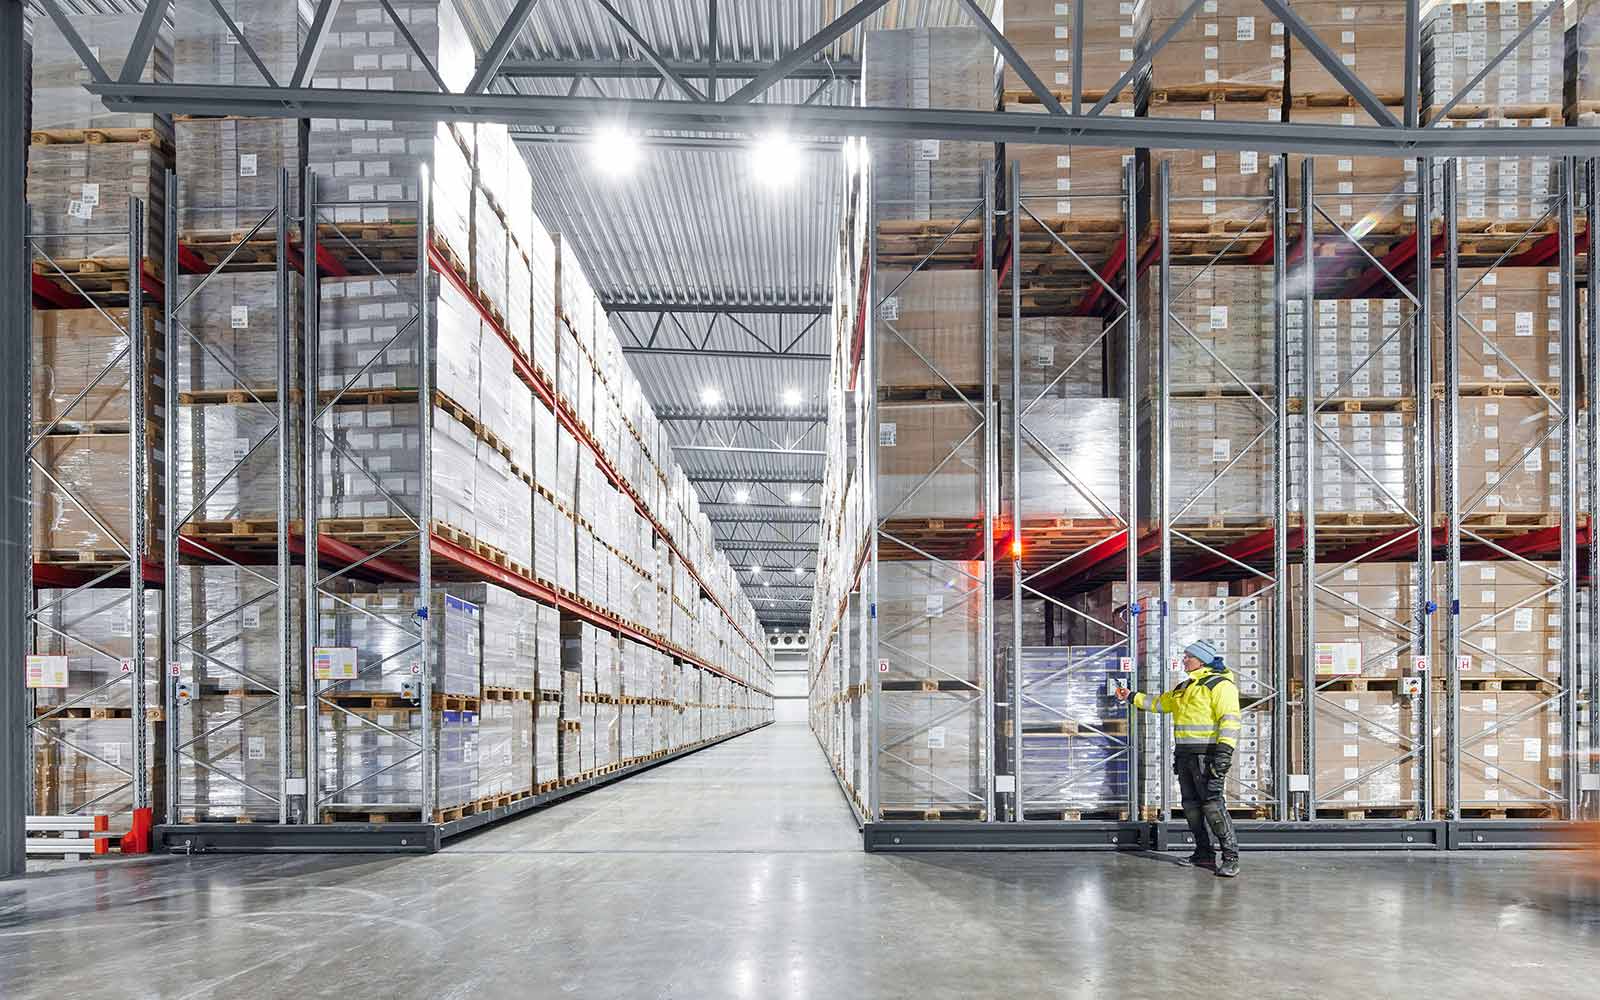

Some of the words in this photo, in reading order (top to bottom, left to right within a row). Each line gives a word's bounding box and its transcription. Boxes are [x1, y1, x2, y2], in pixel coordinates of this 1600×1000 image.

[880, 663, 887, 671] D
[1172, 662, 1178, 670] F
[1418, 661, 1425, 669] G
